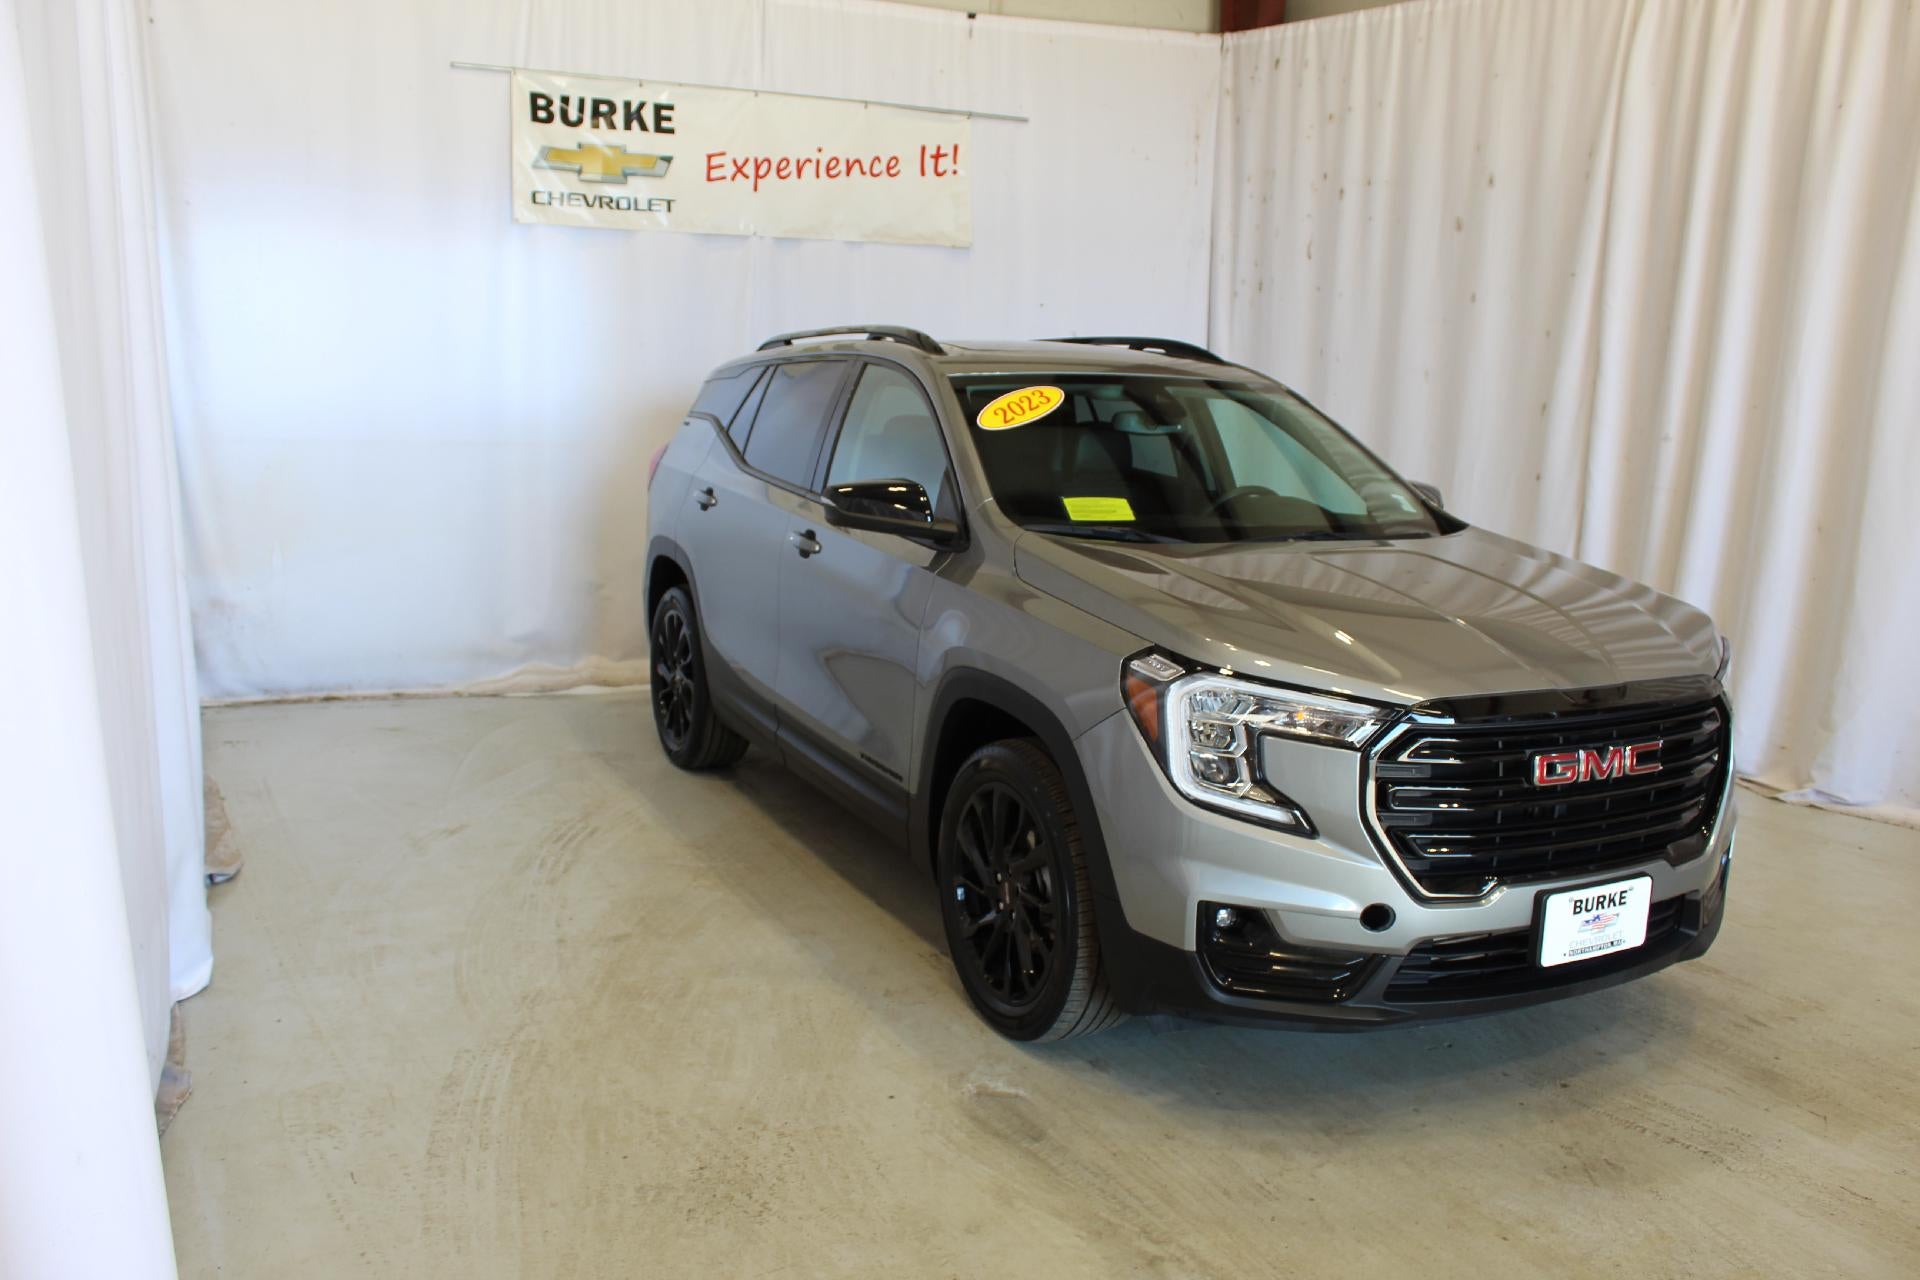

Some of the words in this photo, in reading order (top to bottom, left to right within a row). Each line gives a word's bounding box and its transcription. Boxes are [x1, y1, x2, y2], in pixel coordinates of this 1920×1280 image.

[530, 91, 675, 135] BURKE
[705, 146, 901, 192] Experience
[919, 143, 960, 178] It!
[531, 190, 676, 213] CHEVROLET
[993, 389, 1051, 425] 2023
[1534, 740, 1663, 786] GMC
[1572, 889, 1628, 915] BURKE
